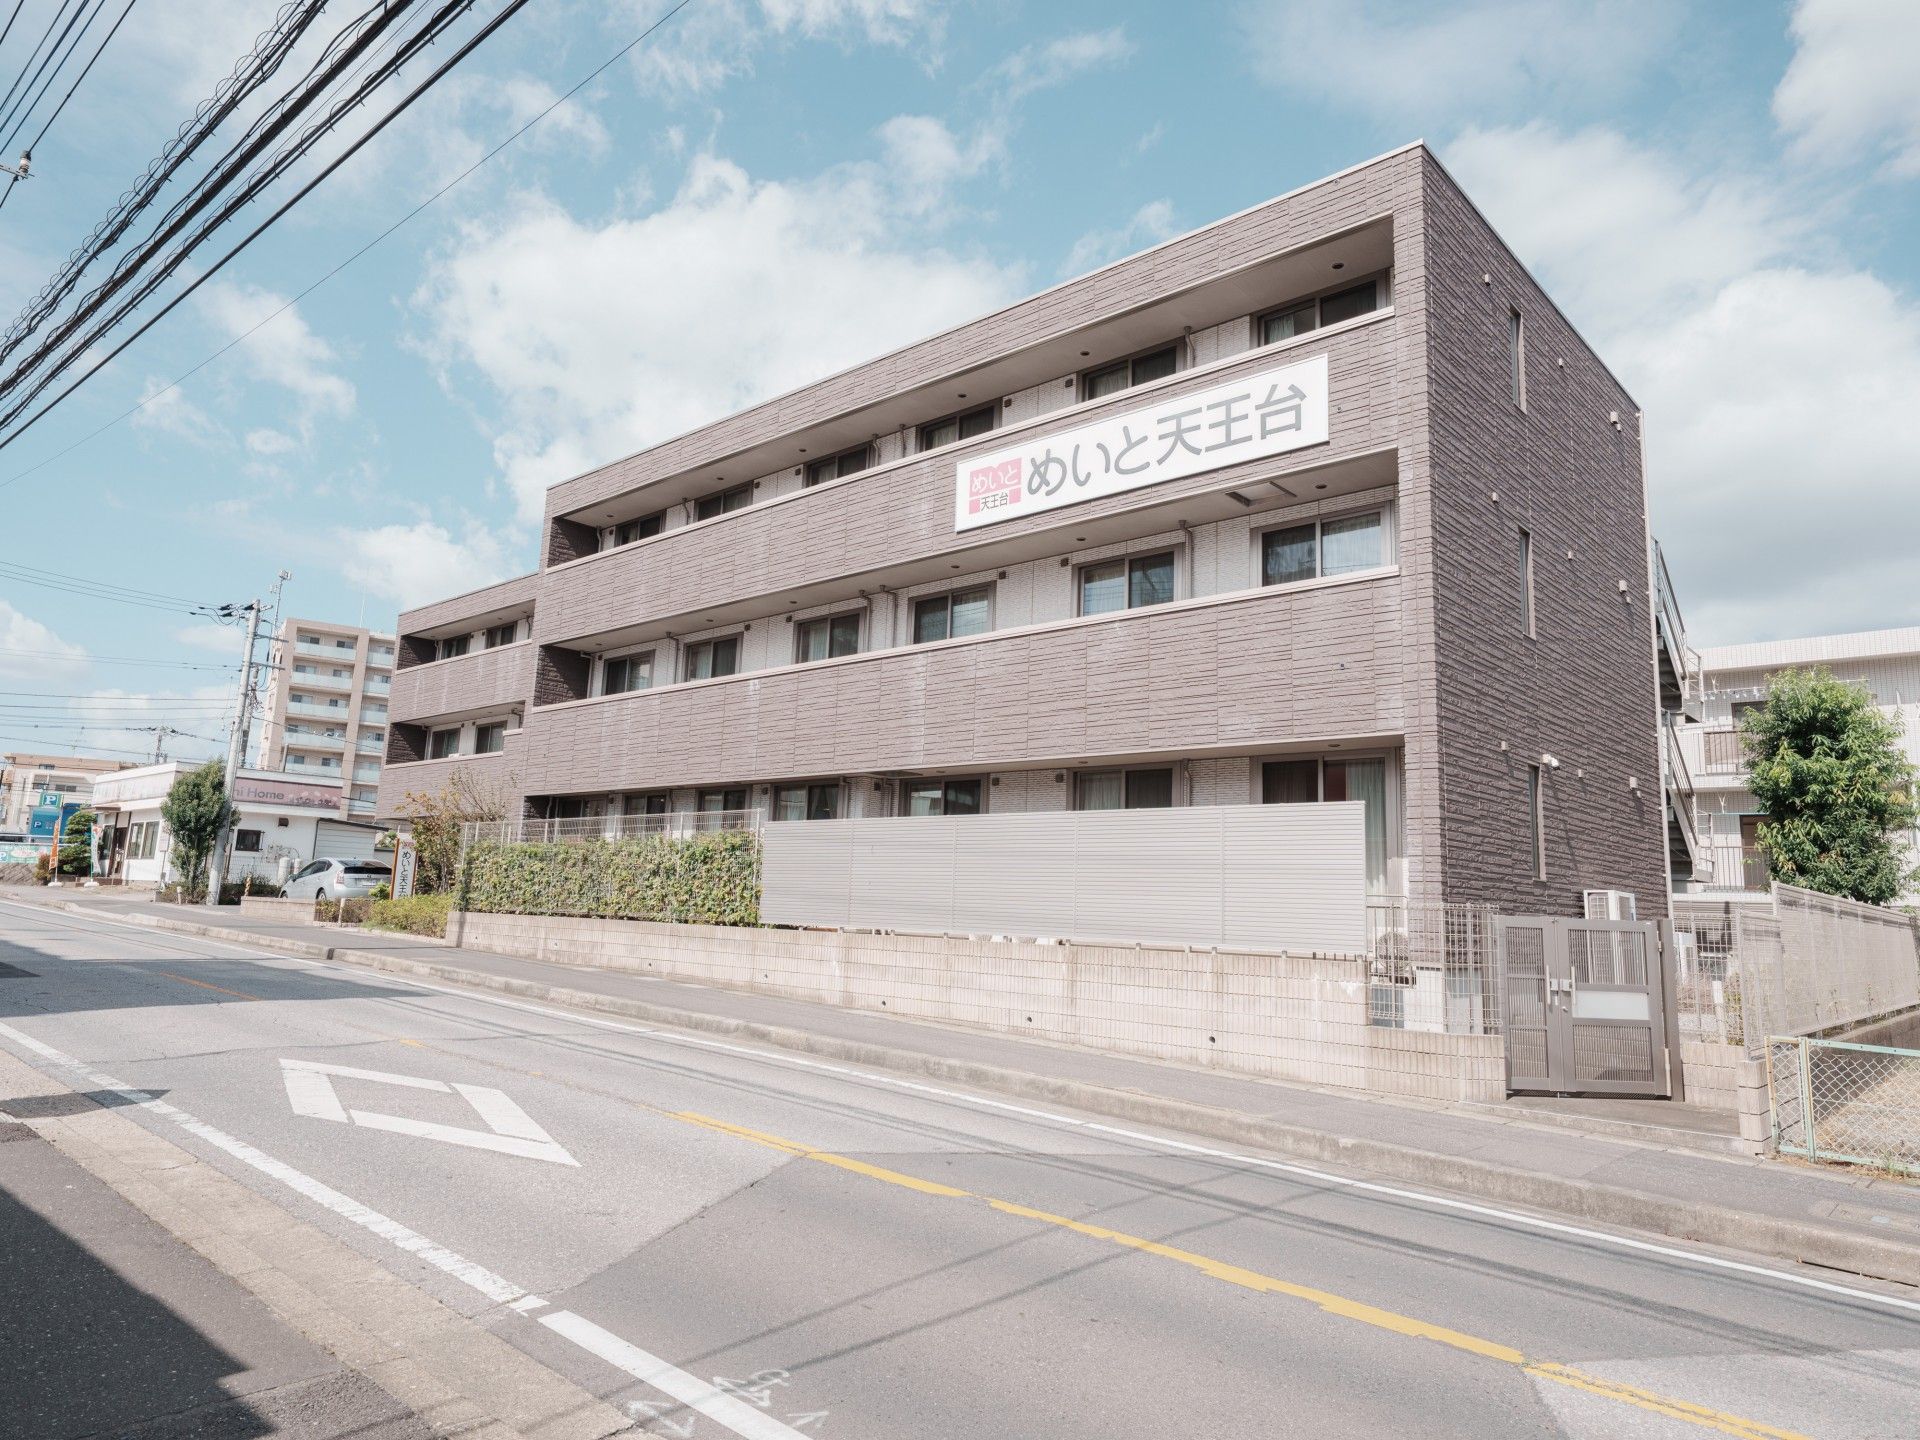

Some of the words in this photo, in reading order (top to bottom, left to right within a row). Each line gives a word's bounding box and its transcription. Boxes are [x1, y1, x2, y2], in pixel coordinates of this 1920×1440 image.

[1027, 384, 1306, 496] めいと天王台
[972, 465, 1018, 494] めいと
[981, 492, 1008, 511] 天王台
[45, 795, 56, 805] P
[247, 787, 285, 800] Home
